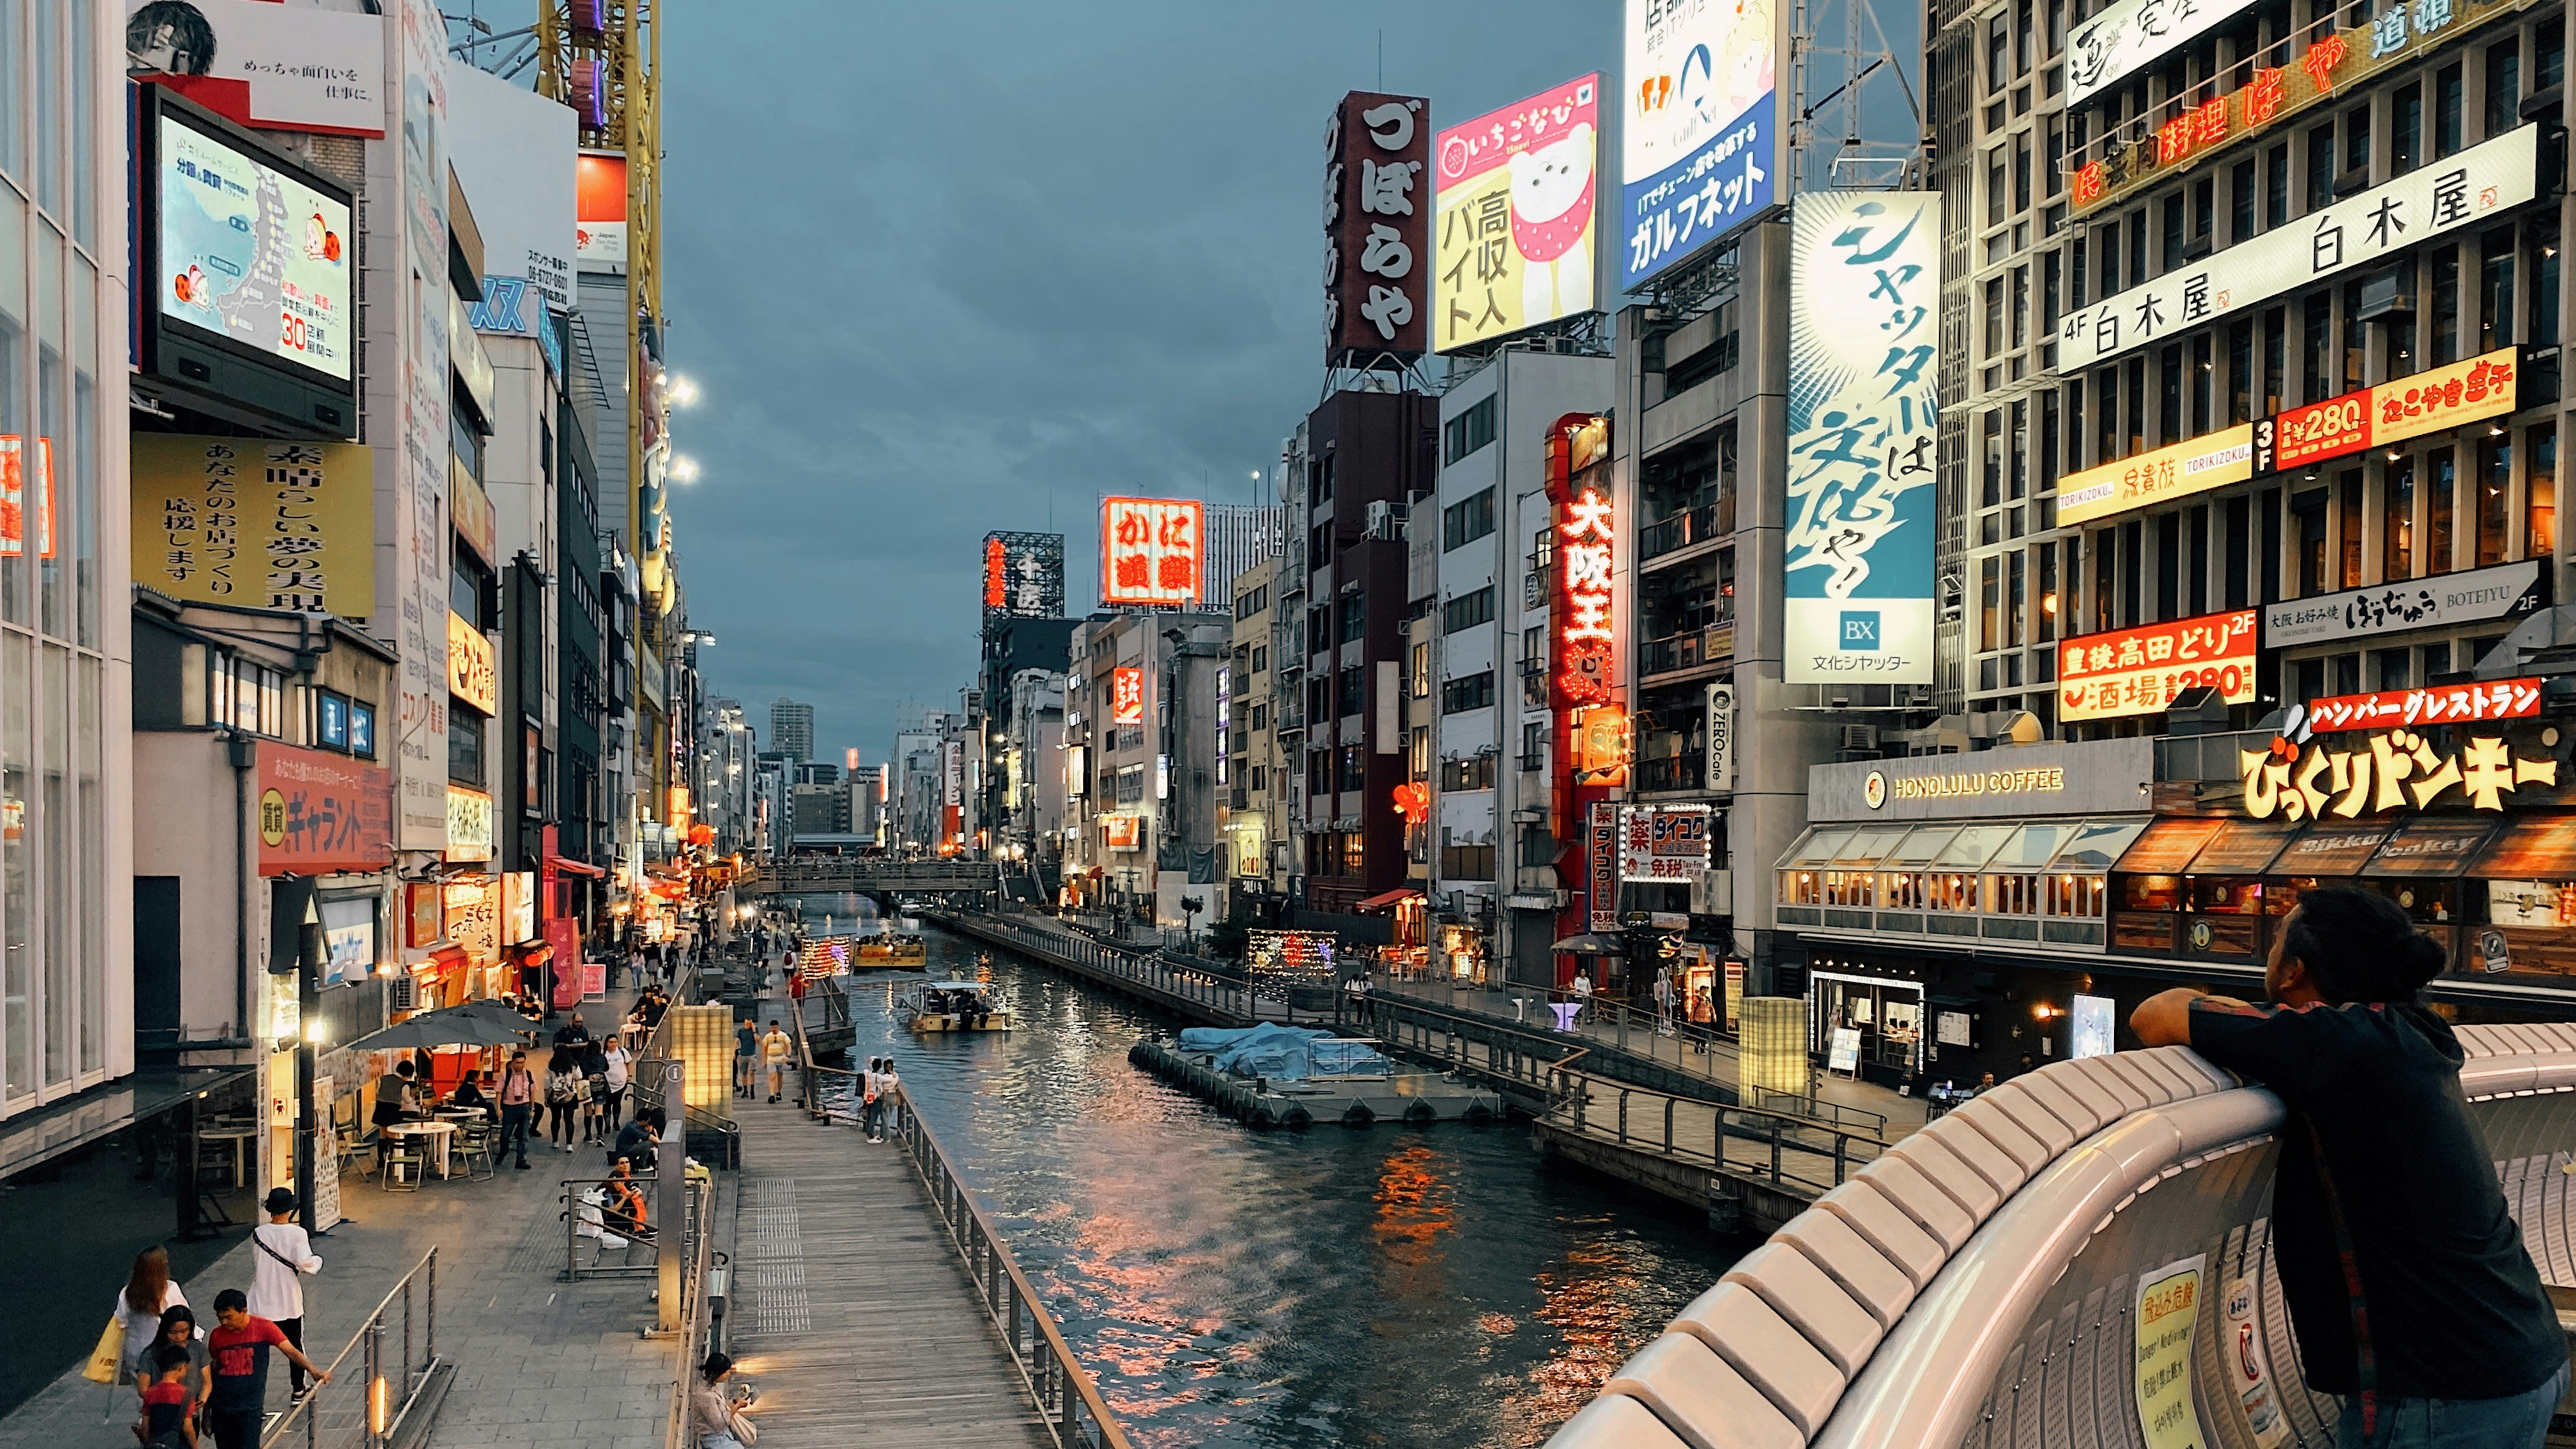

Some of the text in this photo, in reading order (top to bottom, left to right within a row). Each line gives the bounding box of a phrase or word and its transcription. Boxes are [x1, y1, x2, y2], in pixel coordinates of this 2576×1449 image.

[243, 60, 359, 81] めっちゃ面白いを
[325, 86, 373, 103] 仕事に。
[1469, 96, 1575, 157] いちごなび
[1361, 99, 1423, 340] づぼらや
[1630, 151, 1766, 274] ガルフネット
[2311, 169, 2471, 273] 白木屋
[1442, 199, 1475, 341] バイト
[1476, 188, 1511, 333] 高収入
[282, 313, 305, 351] 30
[2065, 273, 2212, 355] 4F 白木屋
[2382, 360, 2513, 424] たこやき王子
[2123, 457, 2175, 500] 鳥貴族
[2187, 447, 2244, 473] TORIKIZOKU
[2060, 484, 2108, 508] TORIKIZOKU
[205, 443, 238, 595] あなたのお店づくり
[266, 445, 327, 613] 素晴らしい夢の実現
[1117, 510, 1192, 549] かに
[163, 497, 197, 583] 応援します
[2271, 604, 2339, 628] 大阪 お好み焼
[2447, 585, 2511, 608] BOTEJYU
[2518, 595, 2538, 611] 2F
[1845, 620, 1876, 640] BX
[2231, 613, 2256, 636] 2F
[2063, 624, 2230, 677] 豊後高田どり
[1117, 676, 1128, 710] ドラッグ
[1127, 671, 1140, 703] ツルハ
[2089, 675, 2161, 710] 酒場
[2311, 684, 2540, 726] ハンバーグレストラン
[1713, 712, 1725, 751] ZERO
[1895, 767, 2065, 799] HONOLULU COFFEE
[2241, 730, 2557, 822] びっくりドンキー
[288, 790, 362, 853] ギャラント
[1630, 814, 1649, 852] 薬
[1654, 816, 1705, 841] ダイコク
[1596, 828, 1612, 881] ダイコク
[1651, 858, 1683, 877] 免税
